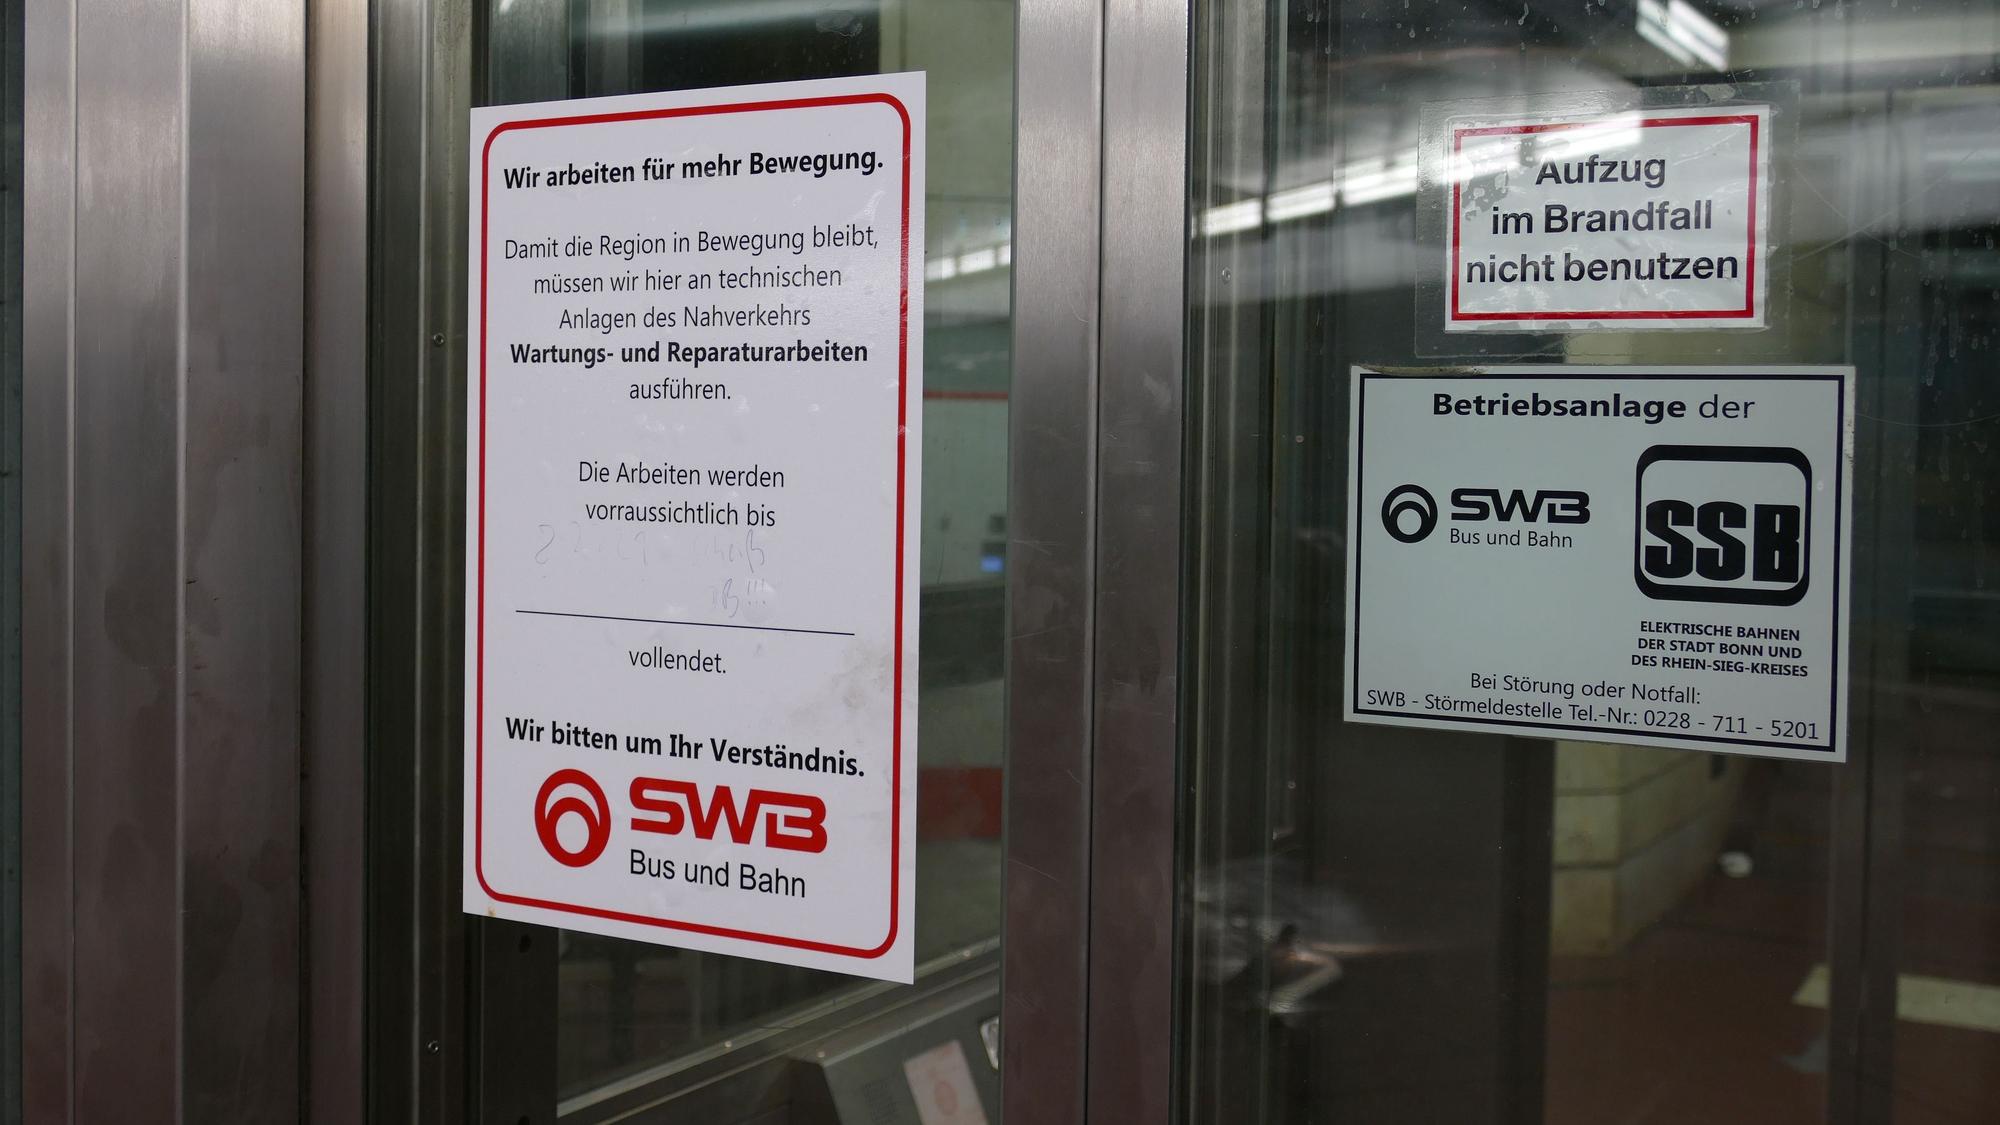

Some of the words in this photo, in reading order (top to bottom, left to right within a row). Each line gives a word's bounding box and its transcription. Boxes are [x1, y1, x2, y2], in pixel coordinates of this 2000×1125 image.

[504, 167, 540, 189] Wir
[547, 162, 634, 186] arbeiten
[642, 158, 674, 180] für
[683, 154, 741, 178] mehr
[750, 150, 883, 178] Bewegung.
[1536, 155, 1665, 188] Aufzug
[1493, 207, 1532, 234] im
[1545, 200, 1711, 233] Brandfall
[506, 238, 558, 259] Damit
[565, 236, 592, 256] die
[601, 233, 665, 260] Region
[674, 232, 689, 252] in
[699, 232, 803, 256] Bewegung
[814, 224, 877, 248] bleibt,
[535, 274, 602, 293] müssen
[610, 271, 638, 291] wir
[646, 270, 681, 290] hier
[689, 274, 710, 289] an
[719, 265, 840, 288] technischen
[1467, 254, 1554, 282] nicht
[1564, 253, 1737, 281] benutzen
[560, 308, 635, 334] Anlagen
[644, 306, 675, 327] des
[685, 304, 810, 326] Nahverkehrs
[511, 344, 613, 368] Wartungs-
[622, 341, 659, 362] und
[668, 340, 867, 368] Reparaturarbeiten
[630, 378, 730, 399] ausführen.
[1434, 393, 1686, 424] Betriebsanlage
[1699, 394, 1755, 418] der
[580, 461, 609, 482] Die
[616, 462, 699, 485] Arbeiten
[708, 465, 783, 487] werden
[586, 501, 737, 525] vorraussichtlich
[748, 504, 775, 526] bis
[1451, 488, 1590, 524] SWB
[1451, 528, 1480, 544] Bus
[1487, 530, 1520, 545] und
[1529, 531, 1571, 547] Bahn
[1644, 499, 1802, 584] SSB
[1641, 621, 1732, 637] ELEKTRISCHE
[1737, 627, 1799, 641] BAHNEN
[629, 646, 725, 673] vollendet.
[1639, 638, 1665, 650] DER
[1670, 640, 1715, 653] STADT
[1720, 643, 1763, 656] BONN
[1769, 646, 1801, 658] UND
[1632, 655, 1657, 666] DES
[1662, 657, 1807, 676] RHEIN-SIEG-KREISES
[1472, 673, 1496, 689] Bei
[1504, 675, 1574, 699] Störung
[1582, 681, 1625, 698] oder
[1632, 684, 1700, 704] Notfall:
[1368, 690, 1405, 706] SWB
[1424, 693, 1563, 719] Störmeldestelle
[1569, 704, 1637, 724] Tel.-Nr.:
[1644, 710, 1690, 728] 0228
[1713, 716, 1747, 733] 711
[1771, 720, 1818, 739] 5201
[506, 717, 544, 742] Wir
[552, 721, 617, 750] bitten
[626, 736, 661, 755] um
[670, 734, 703, 759] Ihr
[710, 738, 864, 776] Verständnis.
[629, 776, 828, 854] SWB
[631, 849, 675, 879] Bus
[685, 862, 728, 887] und
[740, 864, 805, 897] Bahn
